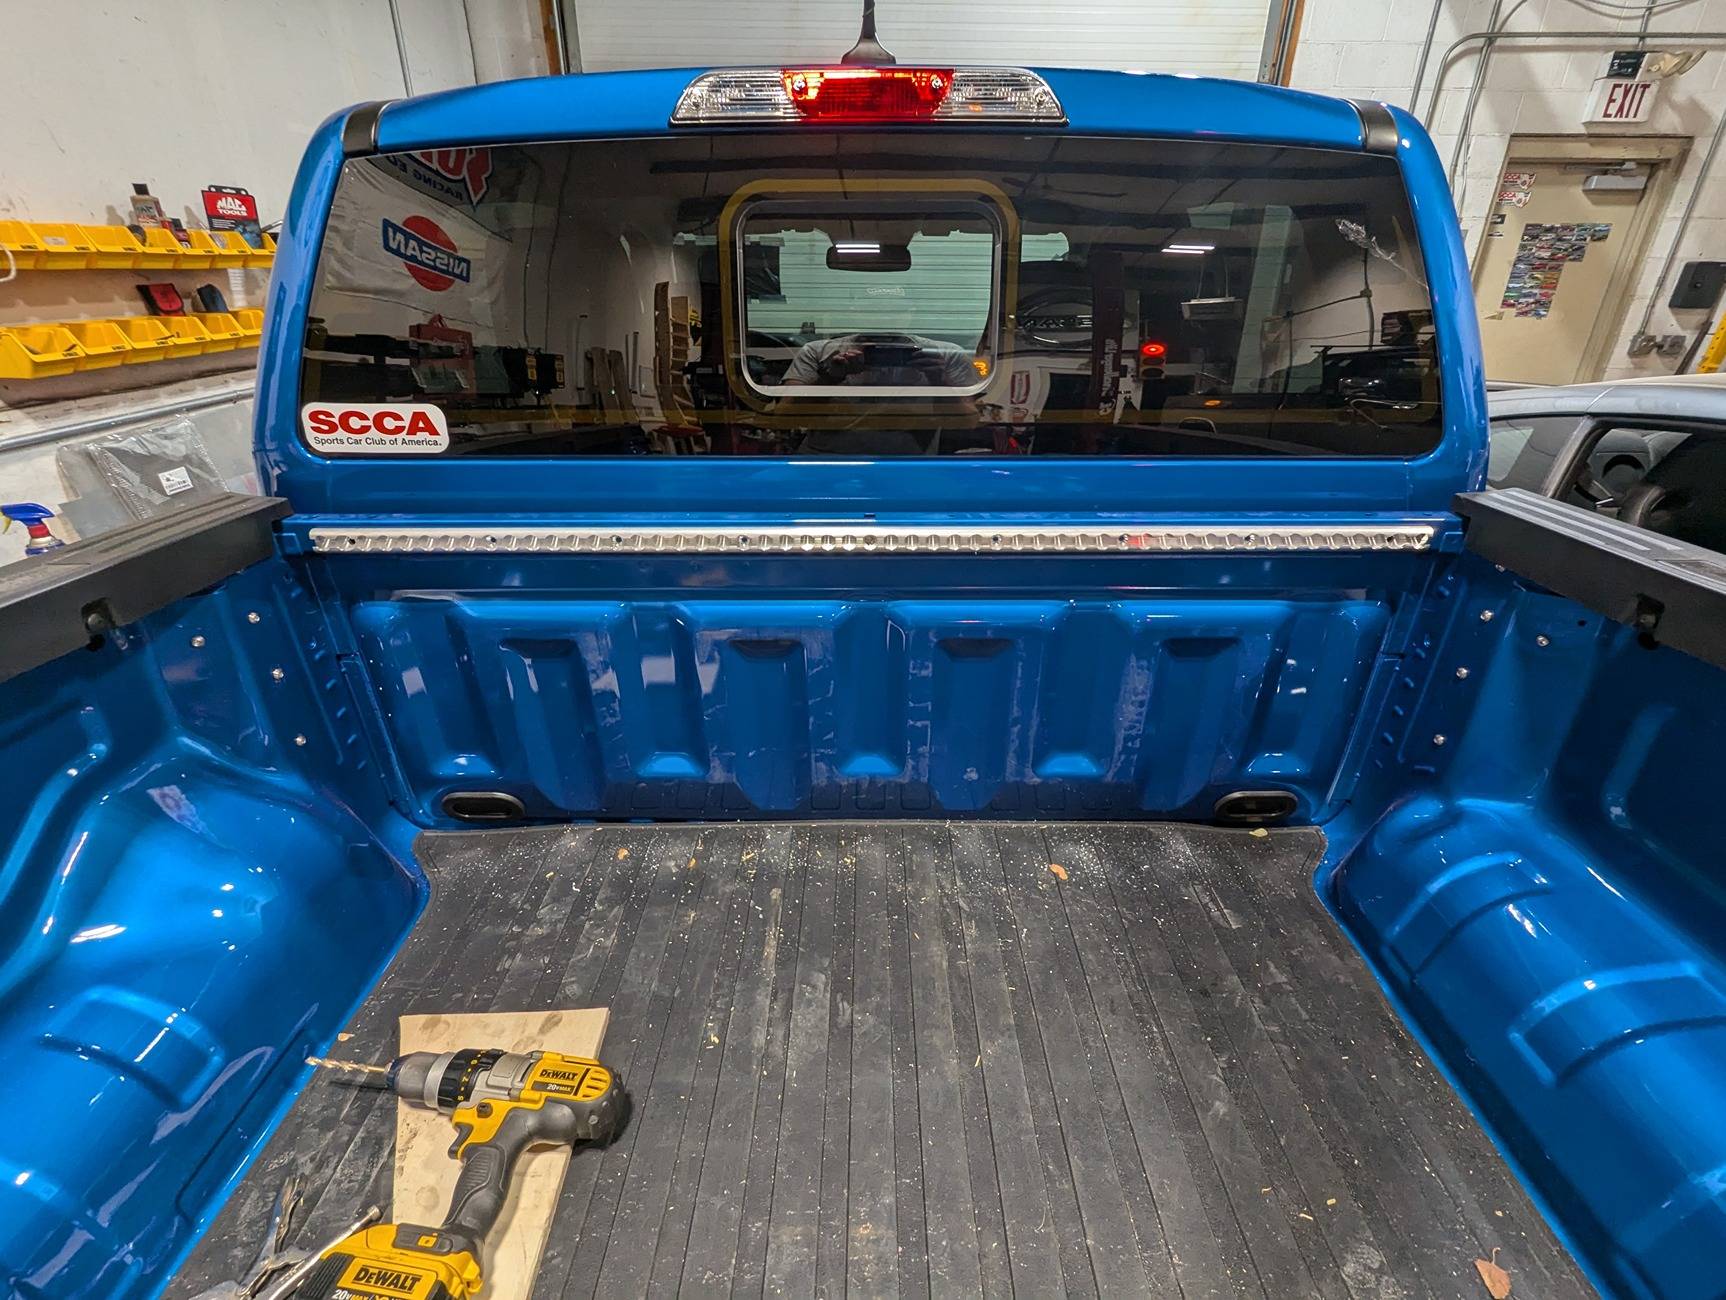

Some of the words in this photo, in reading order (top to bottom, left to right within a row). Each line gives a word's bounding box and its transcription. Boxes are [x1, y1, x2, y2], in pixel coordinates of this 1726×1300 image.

[1602, 83, 1652, 118] EXIT
[216, 196, 247, 210] MAC
[217, 208, 248, 217] TOOLS
[308, 410, 441, 435] SCCA
[314, 436, 345, 446] Sports
[346, 437, 363, 445] Car
[365, 437, 387, 446] Club
[388, 438, 398, 446] of
[352, 1266, 422, 1292] DEWALT
